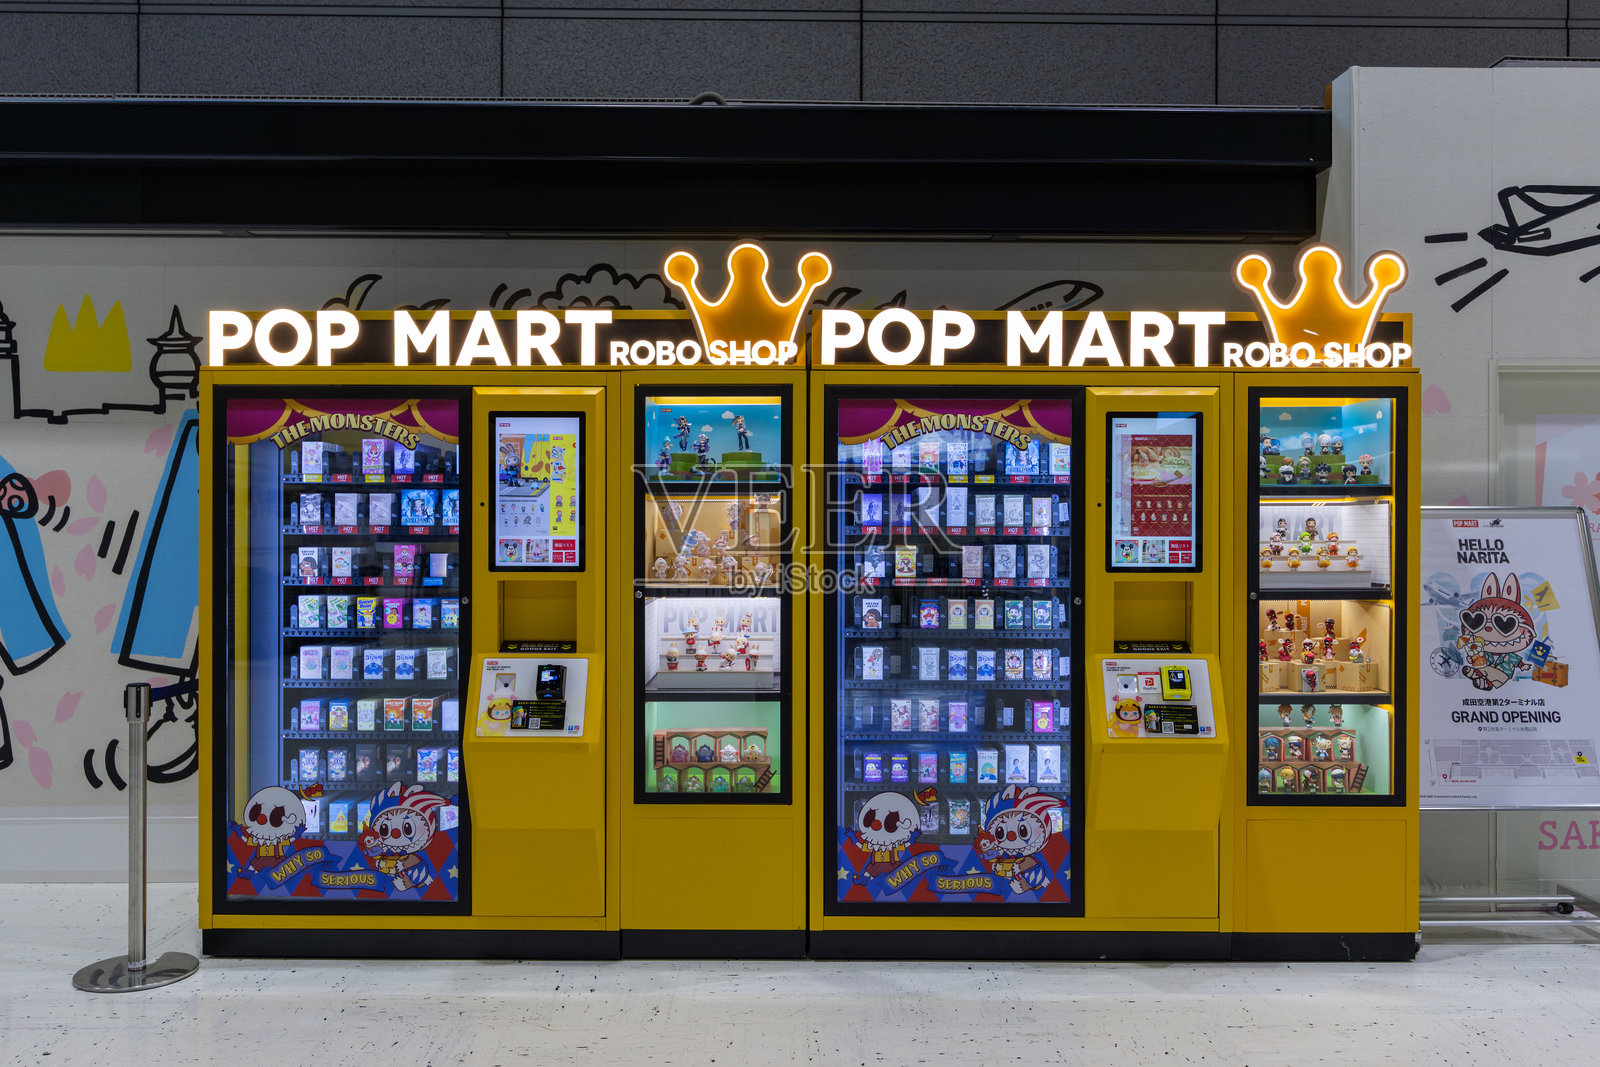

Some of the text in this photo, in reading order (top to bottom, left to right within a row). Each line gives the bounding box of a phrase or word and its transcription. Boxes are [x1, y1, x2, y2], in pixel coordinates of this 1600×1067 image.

[208, 309, 613, 366] POP MART
[821, 308, 1226, 367] POP MART
[609, 340, 798, 366] ROBO SHOP
[1223, 341, 1412, 368] ROBO SHOP
[270, 412, 421, 450] THE MONSTERS
[880, 413, 1032, 451] THE MONSTERS
[1457, 551, 1510, 564] NARITA
[1458, 539, 1504, 551] HELLO
[1462, 698, 1545, 706] 成田空港第2ターミナル店
[1451, 710, 1561, 723] GRAND OPENING
[271, 850, 322, 882] WHY SO
[887, 854, 938, 888] WHY SO
[321, 873, 376, 887] SERIOUS
[937, 877, 992, 891] SERIOUS
